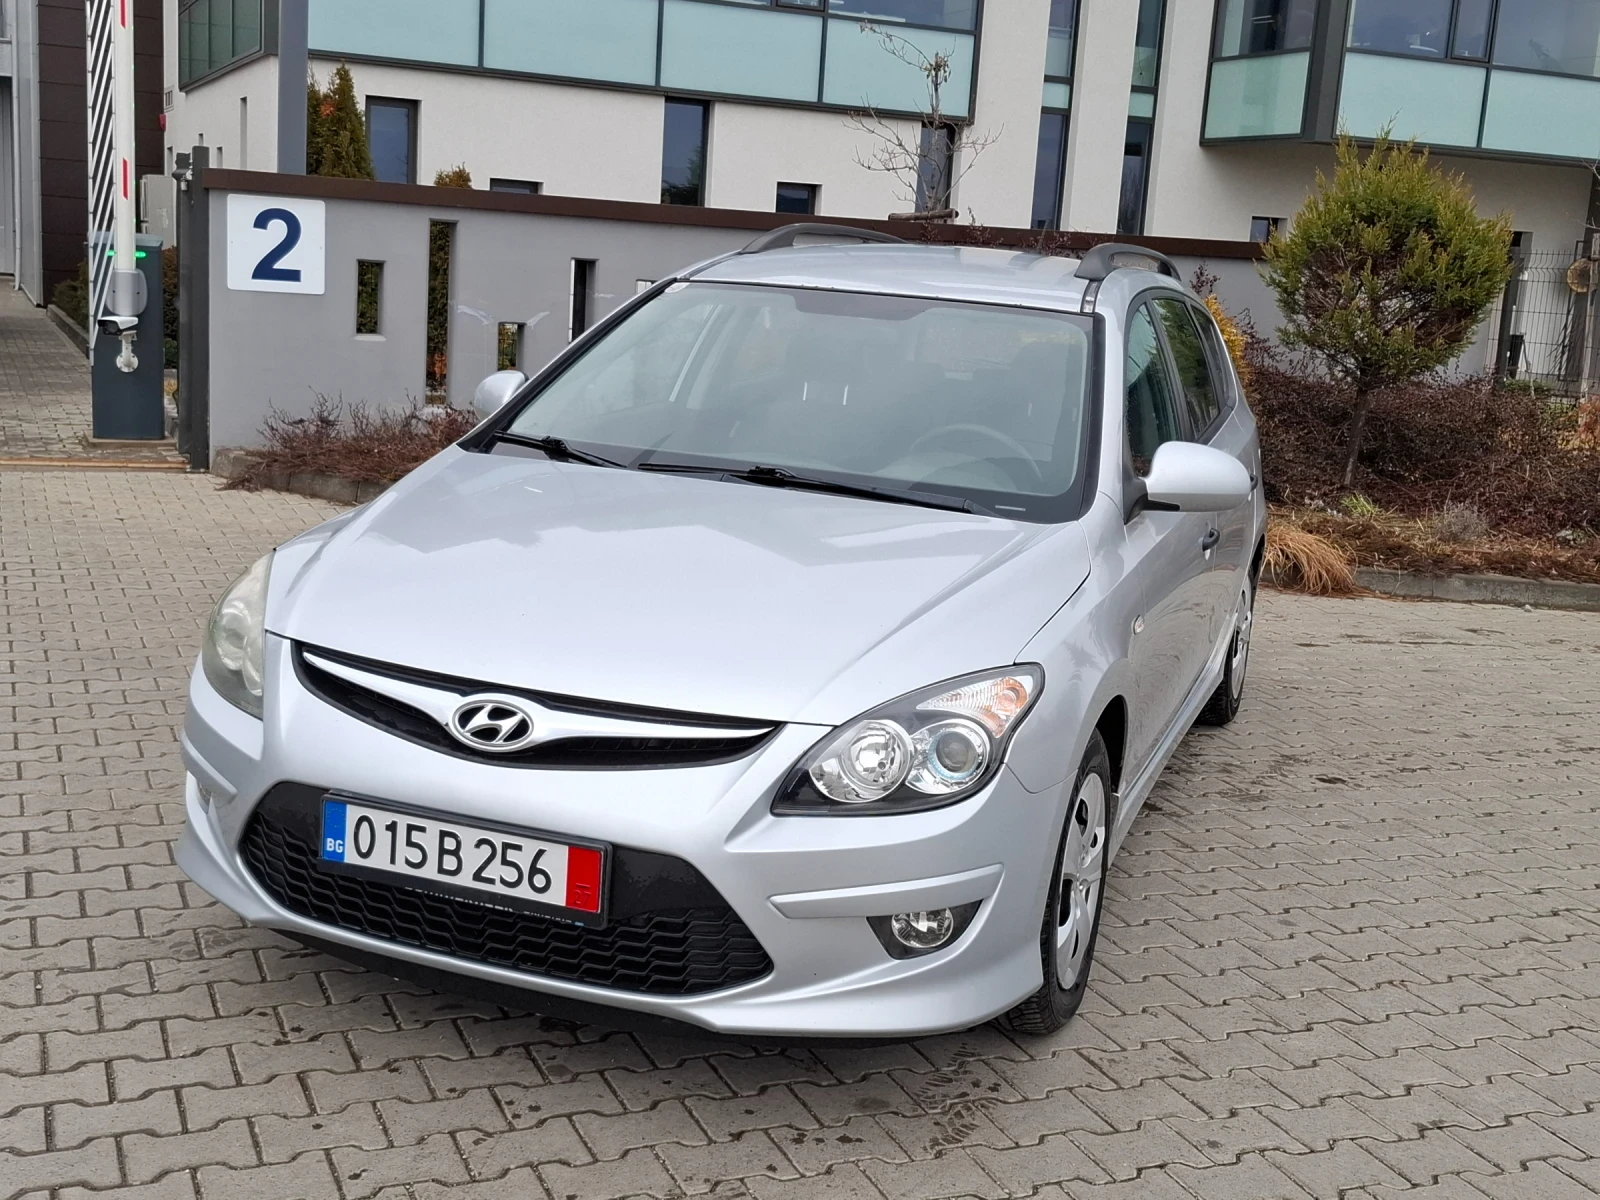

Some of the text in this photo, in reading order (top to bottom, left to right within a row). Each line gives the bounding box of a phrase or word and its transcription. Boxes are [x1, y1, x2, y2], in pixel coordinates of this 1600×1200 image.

[251, 207, 302, 283] 2
[326, 837, 344, 853] BG
[353, 814, 552, 894] 015B256
